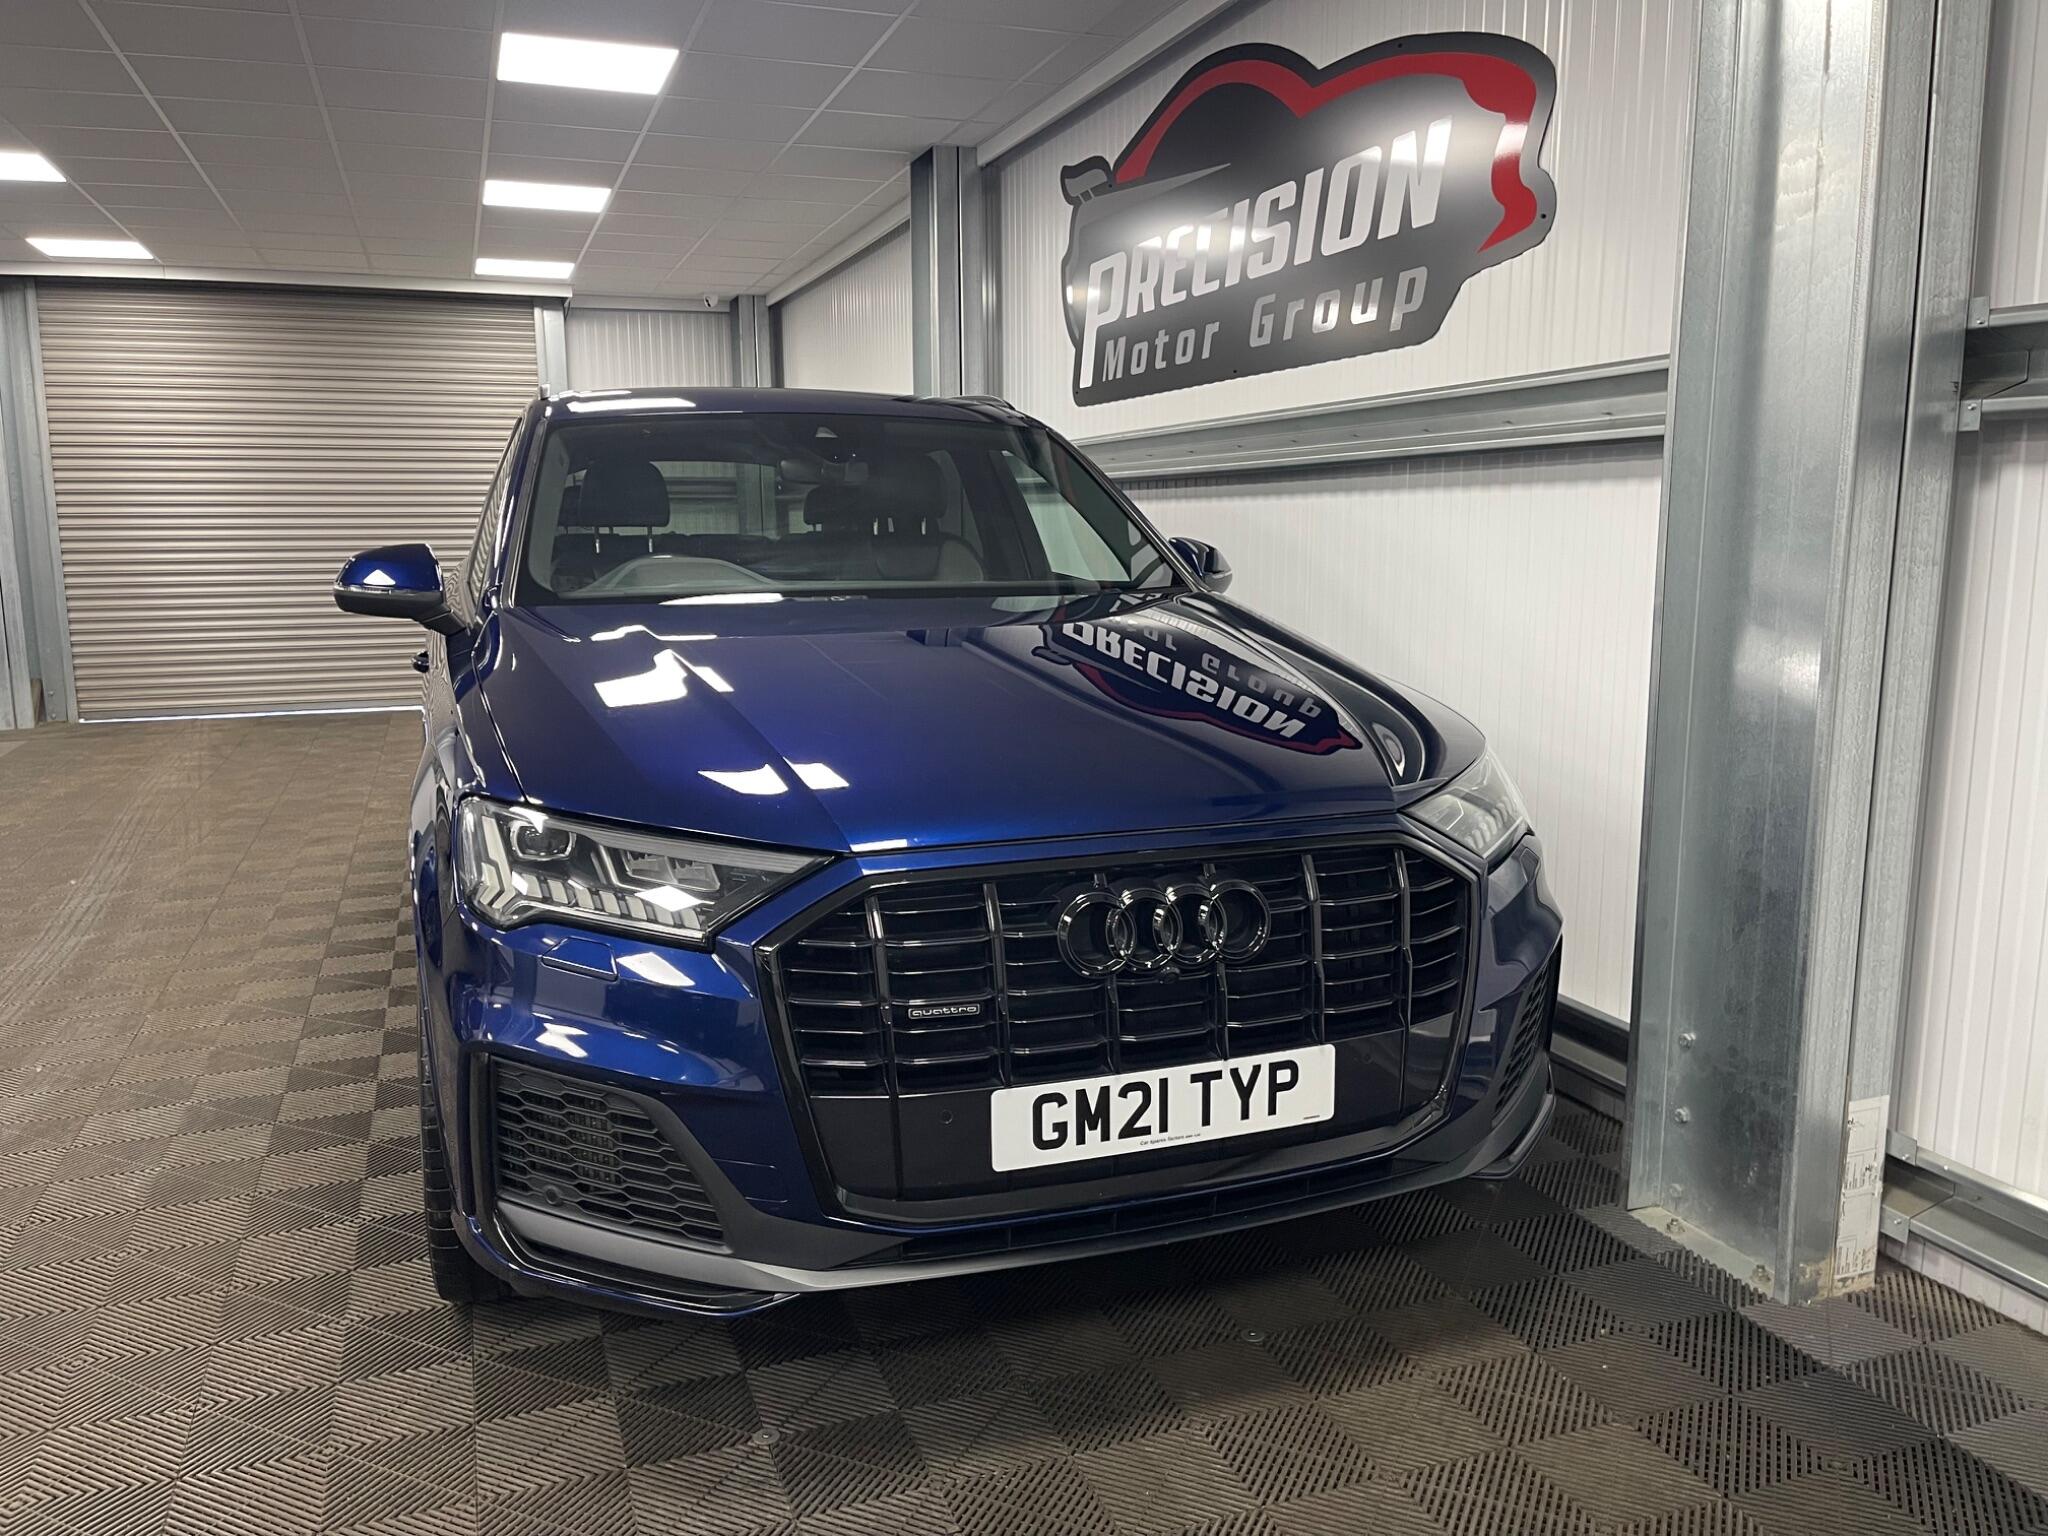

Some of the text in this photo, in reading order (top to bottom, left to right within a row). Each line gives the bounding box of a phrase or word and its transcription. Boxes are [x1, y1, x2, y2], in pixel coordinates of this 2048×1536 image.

[1080, 115, 1454, 388] PRECISION
[1102, 266, 1428, 382] Motor Group
[912, 1006, 977, 1017] quattro
[1032, 1059, 1299, 1151] GM21 TYP
